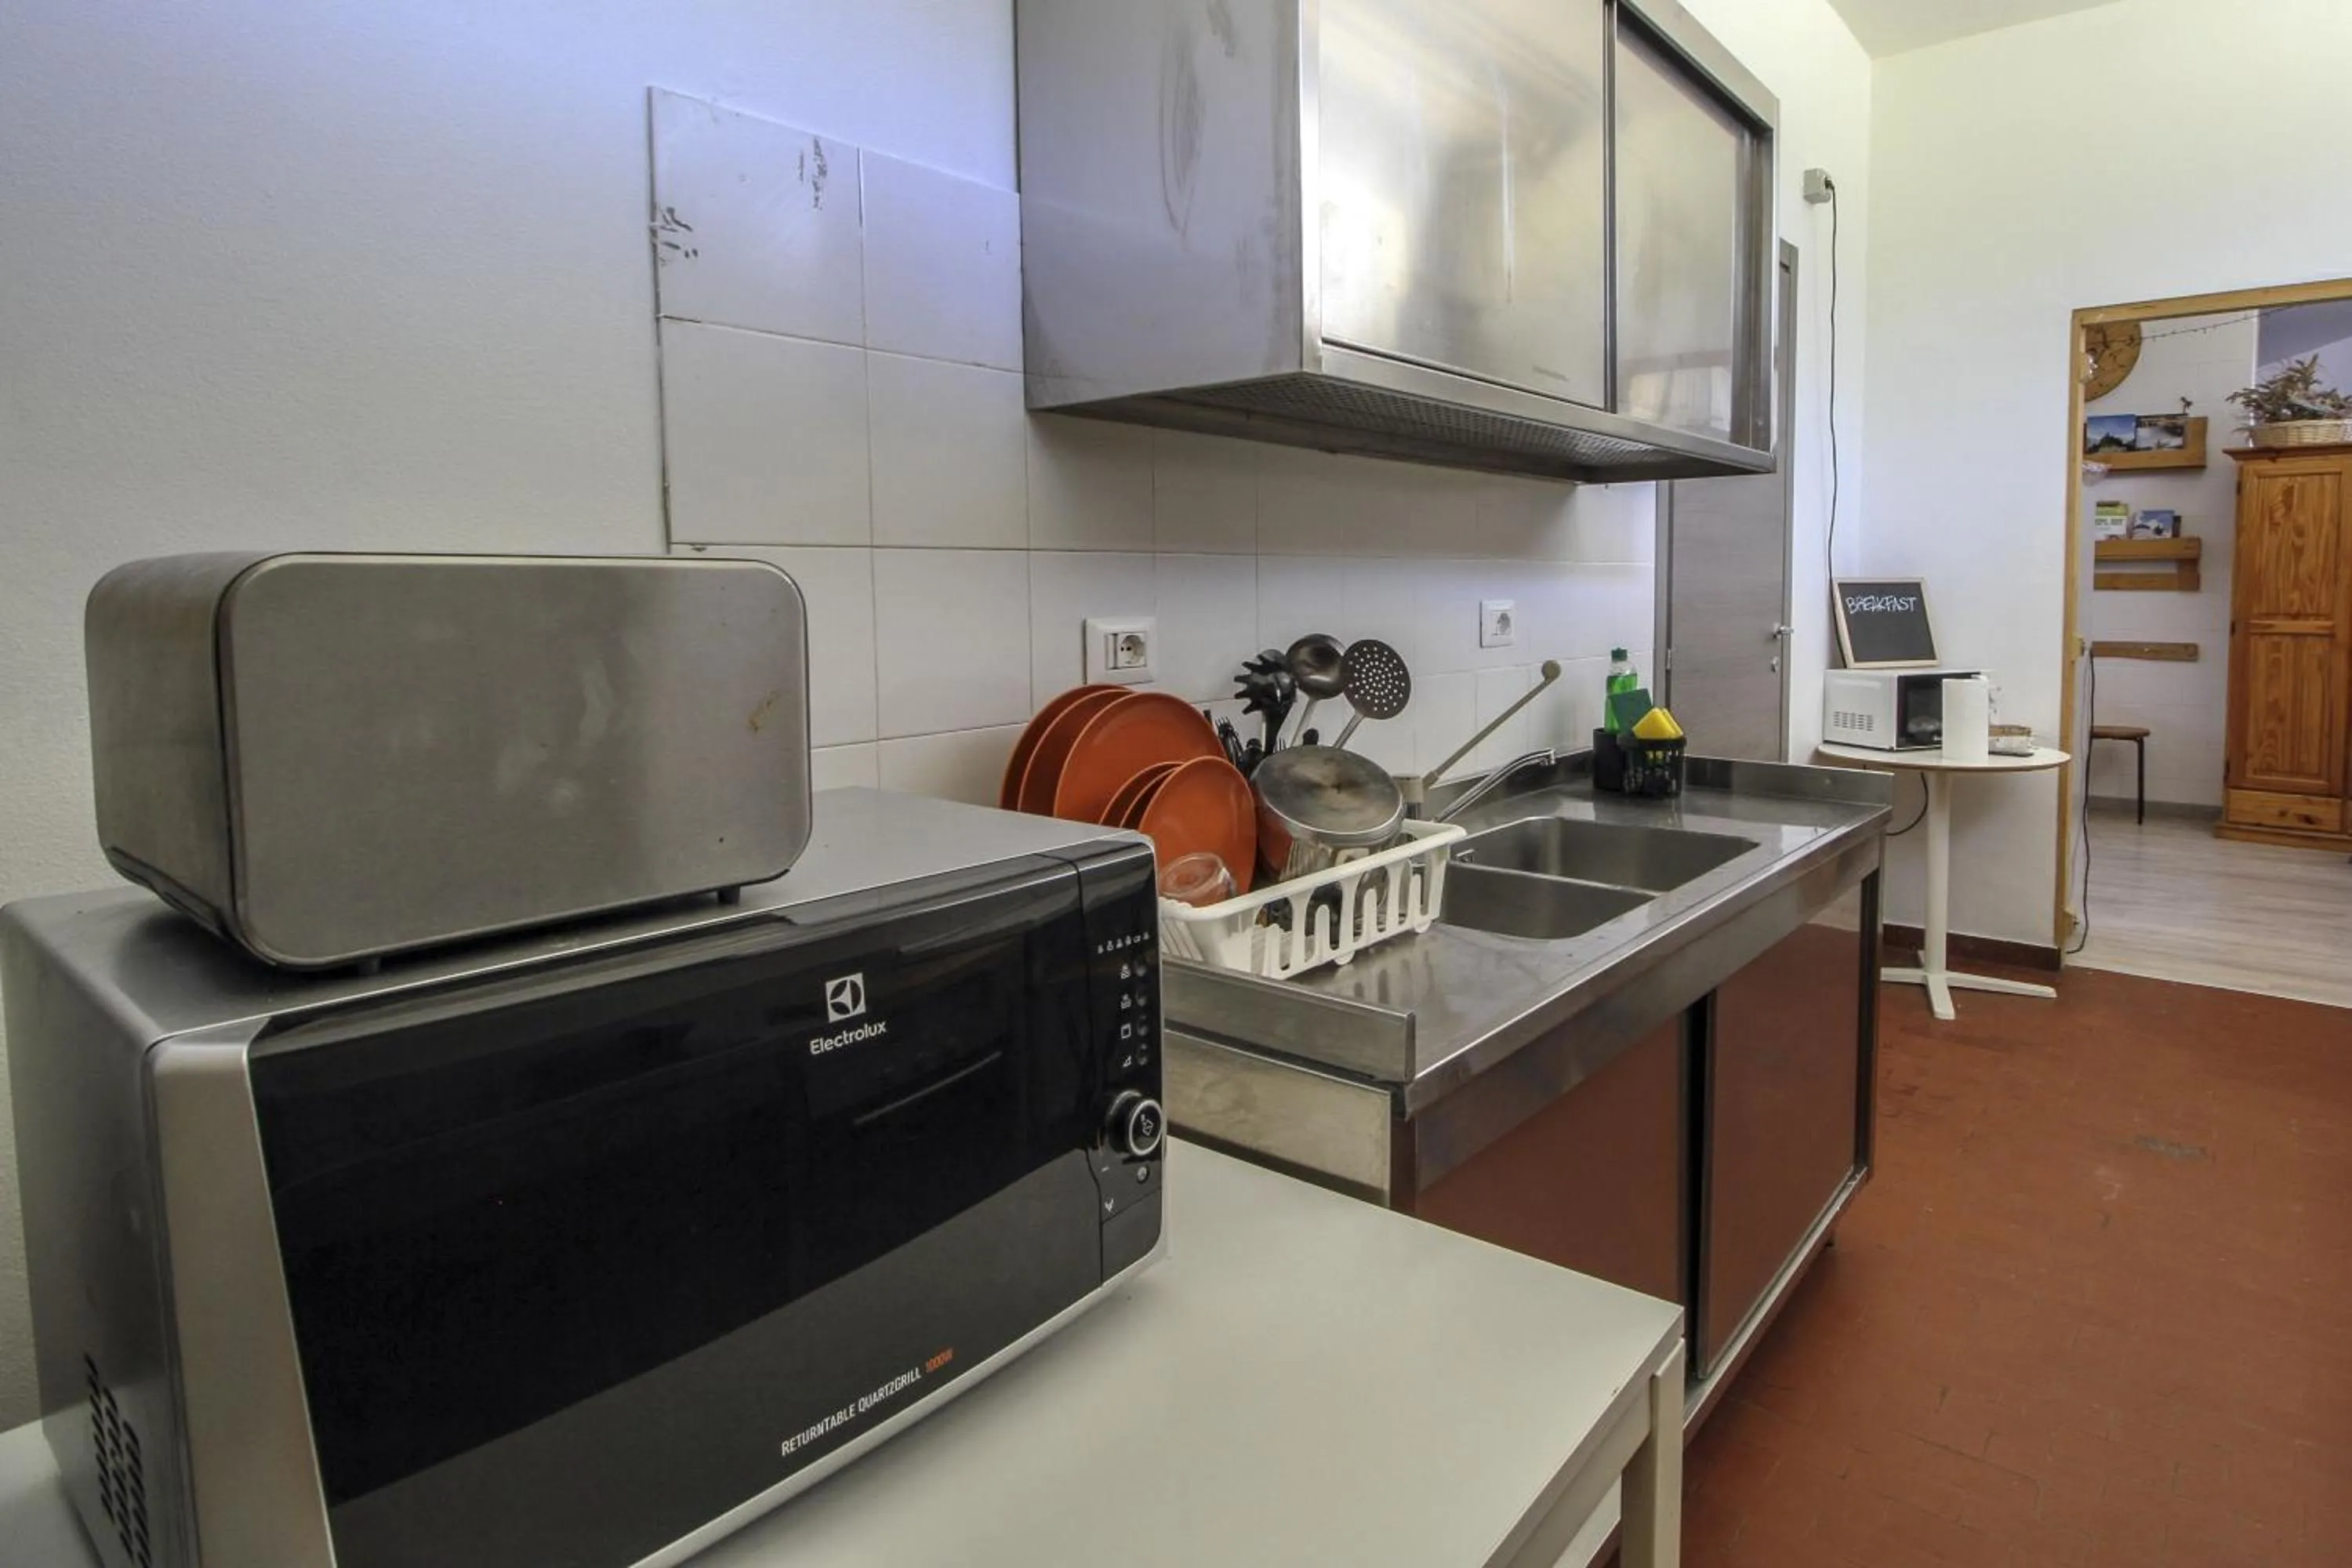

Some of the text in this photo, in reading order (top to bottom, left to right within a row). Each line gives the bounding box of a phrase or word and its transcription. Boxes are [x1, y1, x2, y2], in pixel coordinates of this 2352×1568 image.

[1846, 595, 1917, 614] BREAKFAST
[809, 1021, 887, 1055] Electrolux
[782, 1403, 856, 1457] RETURNTABLE
[858, 1367, 922, 1412] QUARTZGRILL
